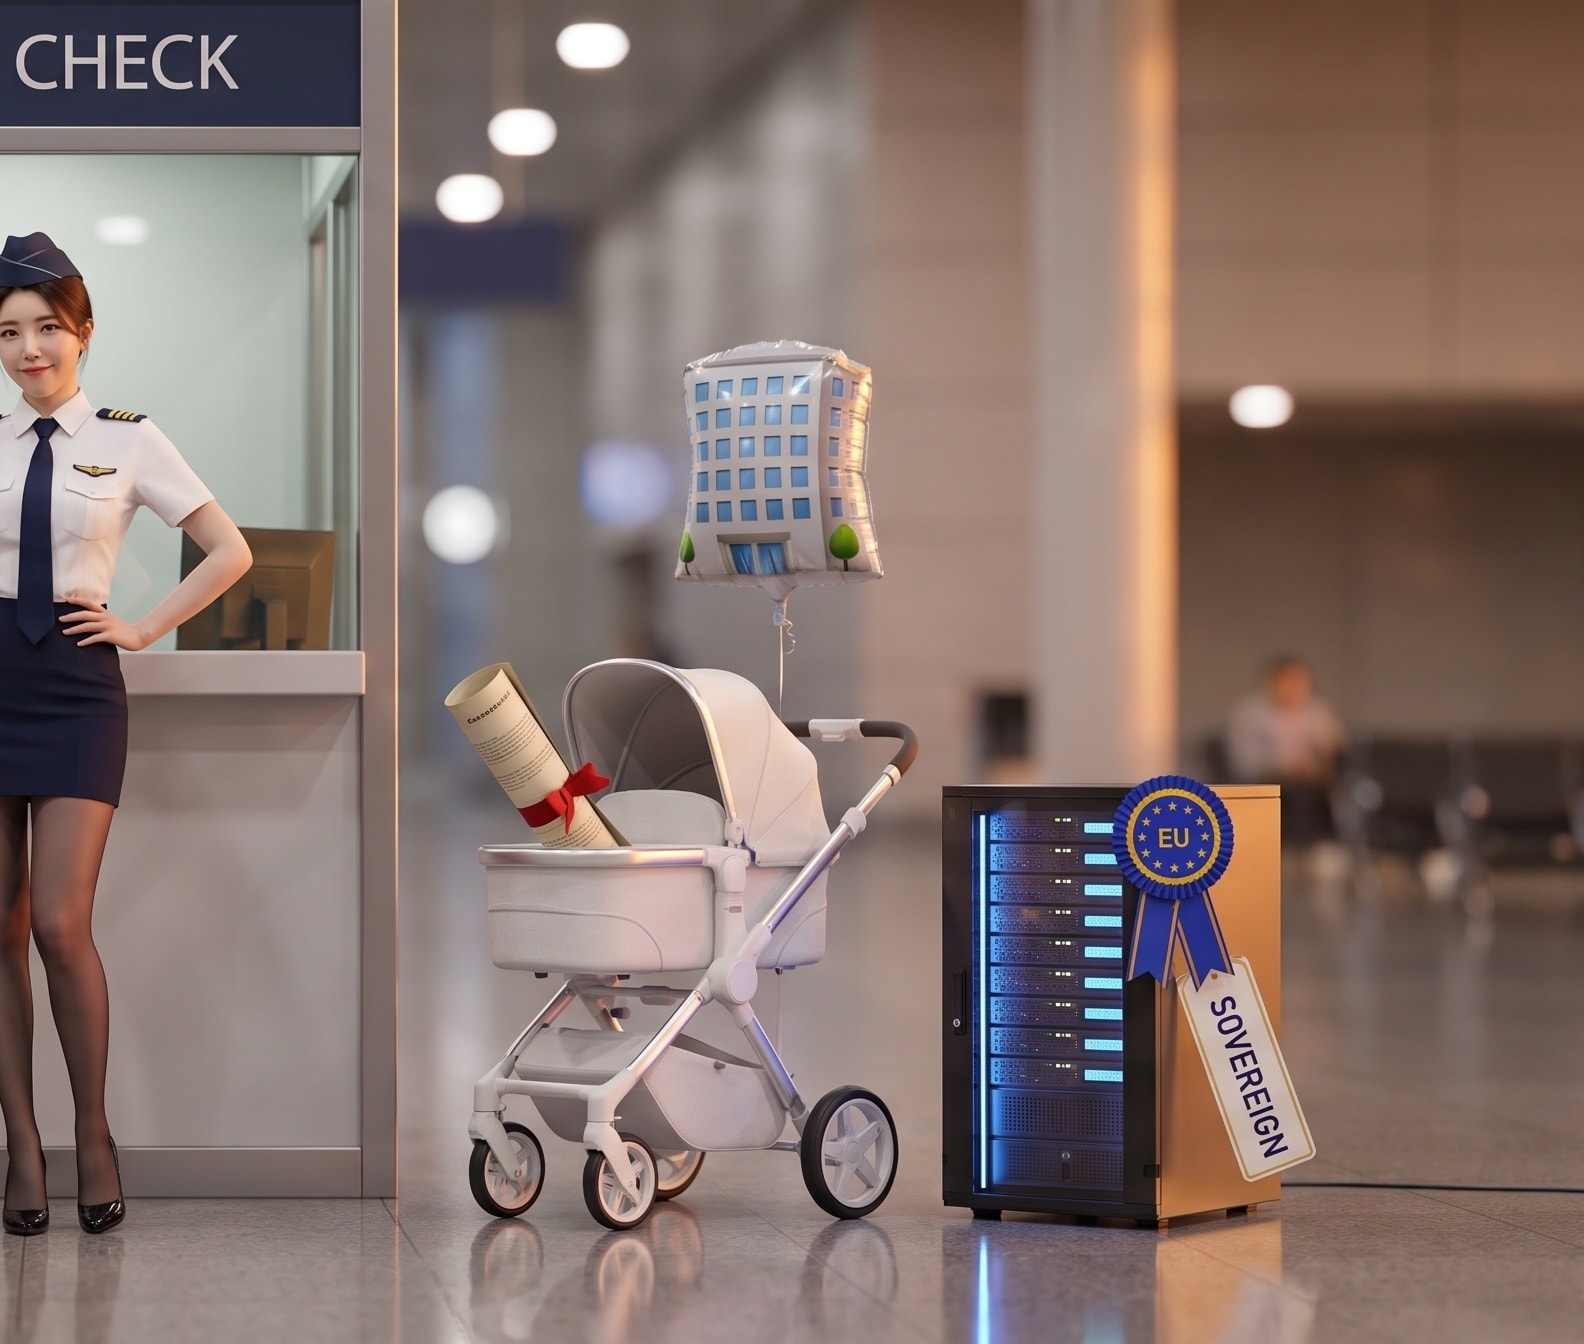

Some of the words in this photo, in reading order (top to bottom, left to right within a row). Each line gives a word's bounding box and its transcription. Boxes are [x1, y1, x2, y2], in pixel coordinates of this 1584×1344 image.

[16, 33, 239, 90] CHECK
[1158, 827, 1190, 848] EU
[1210, 995, 1289, 1159] SOVEREIGN
